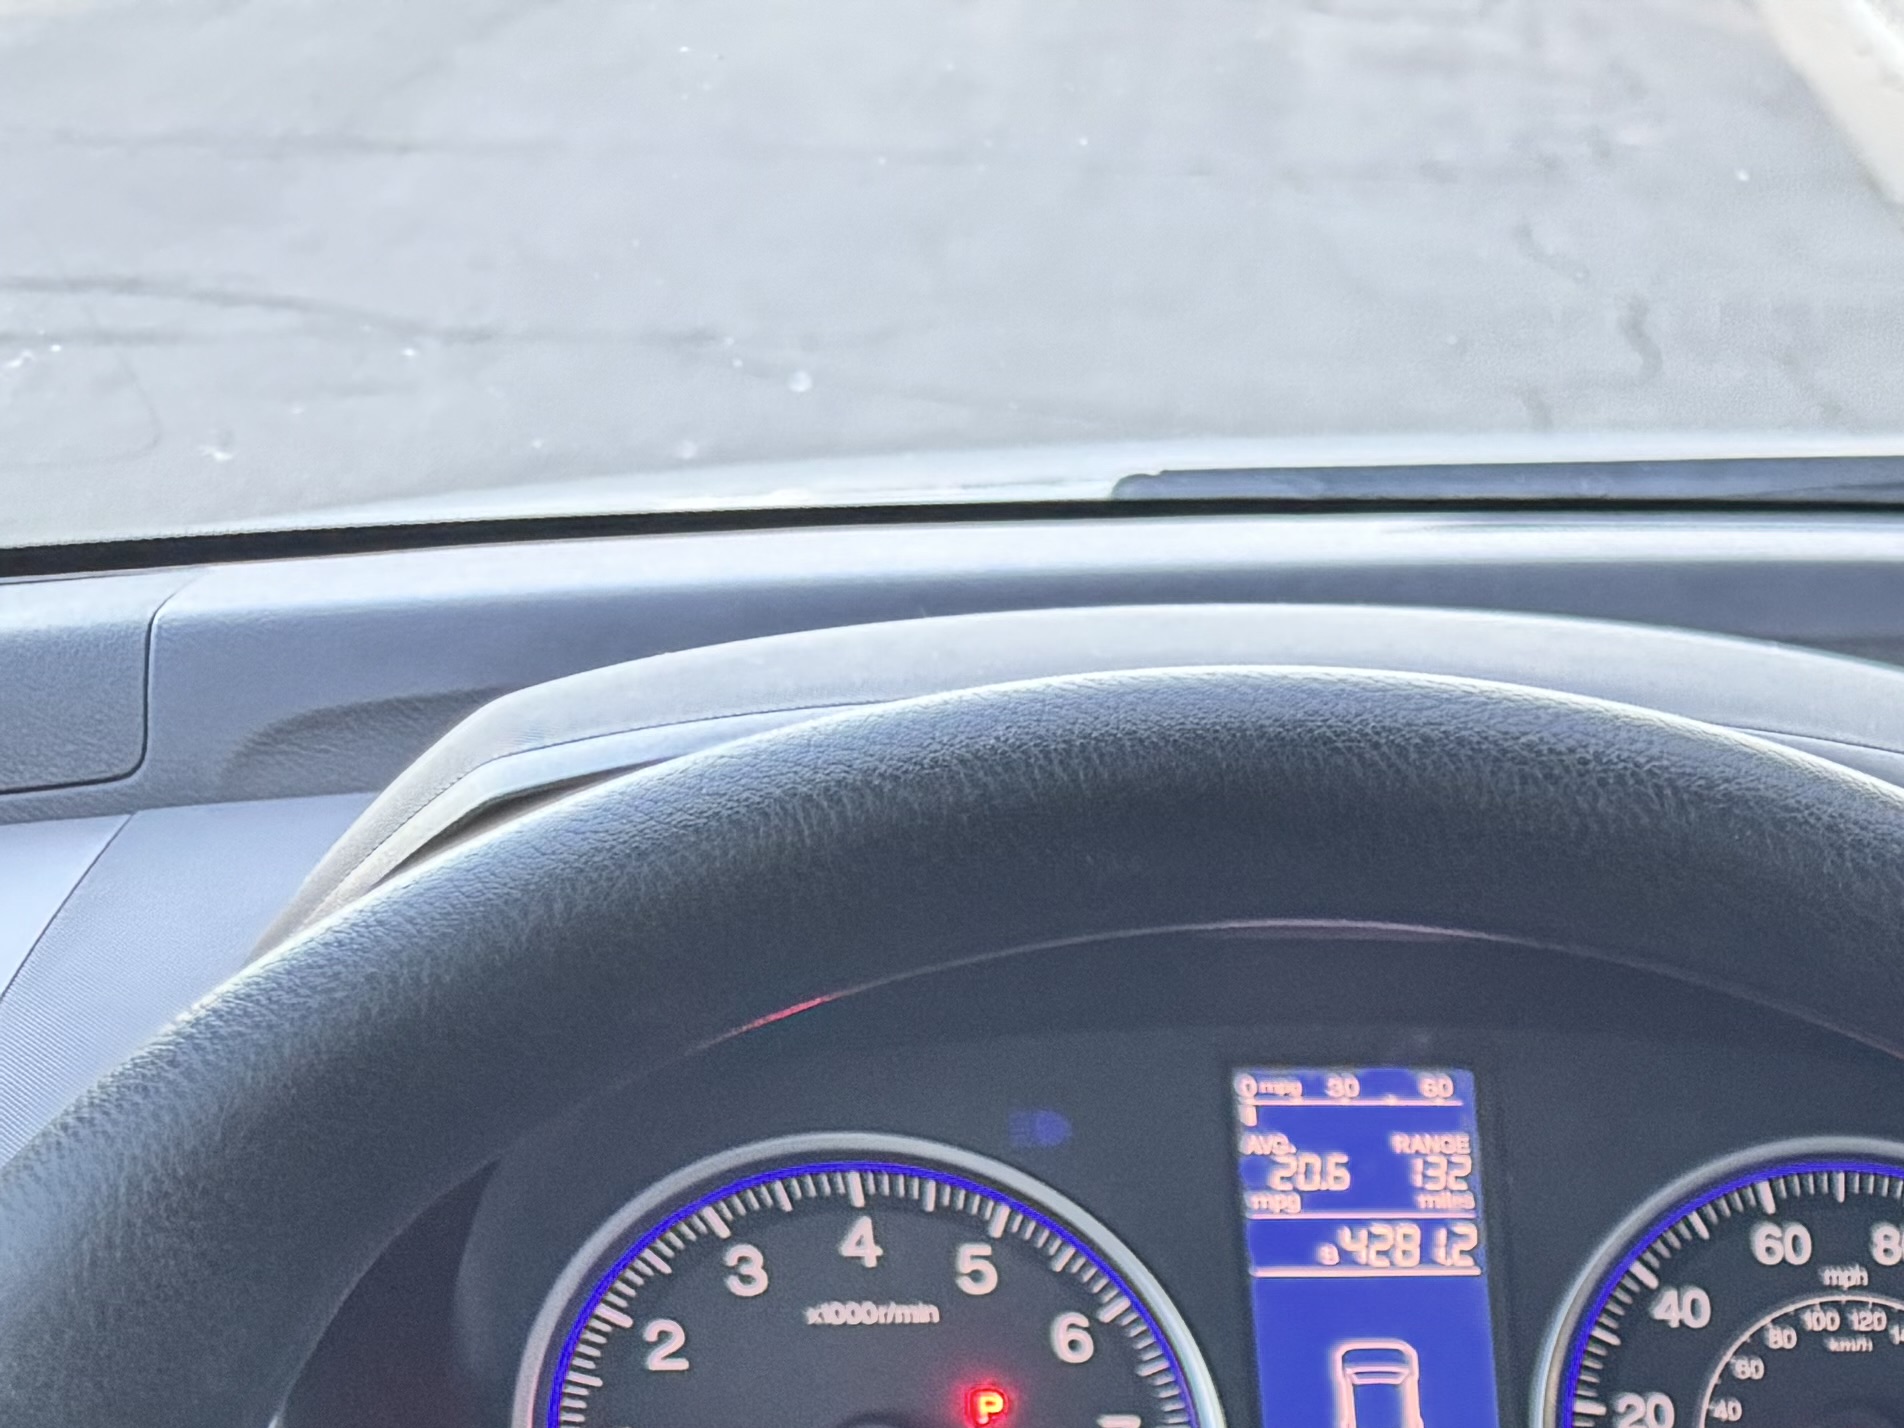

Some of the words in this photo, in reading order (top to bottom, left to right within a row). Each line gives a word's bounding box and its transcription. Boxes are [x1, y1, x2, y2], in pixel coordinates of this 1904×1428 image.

[1390, 1133, 1471, 1154] RANGE
[1410, 1154, 1472, 1191] 132
[839, 1216, 883, 1267] 4
[1750, 1223, 1813, 1265] 60
[724, 1244, 768, 1297] 3
[957, 1244, 999, 1295] 5
[1819, 1265, 1869, 1289] mph
[1652, 1288, 1711, 1328] 40
[1802, 1309, 1841, 1332] 100
[1849, 1309, 1887, 1332] 120
[644, 1319, 689, 1371] 2
[1051, 1313, 1094, 1363] 6
[1765, 1326, 1797, 1350] 80
[1733, 1356, 1765, 1380] 60
[976, 1390, 1005, 1425] P
[1711, 1397, 1743, 1422] 40
